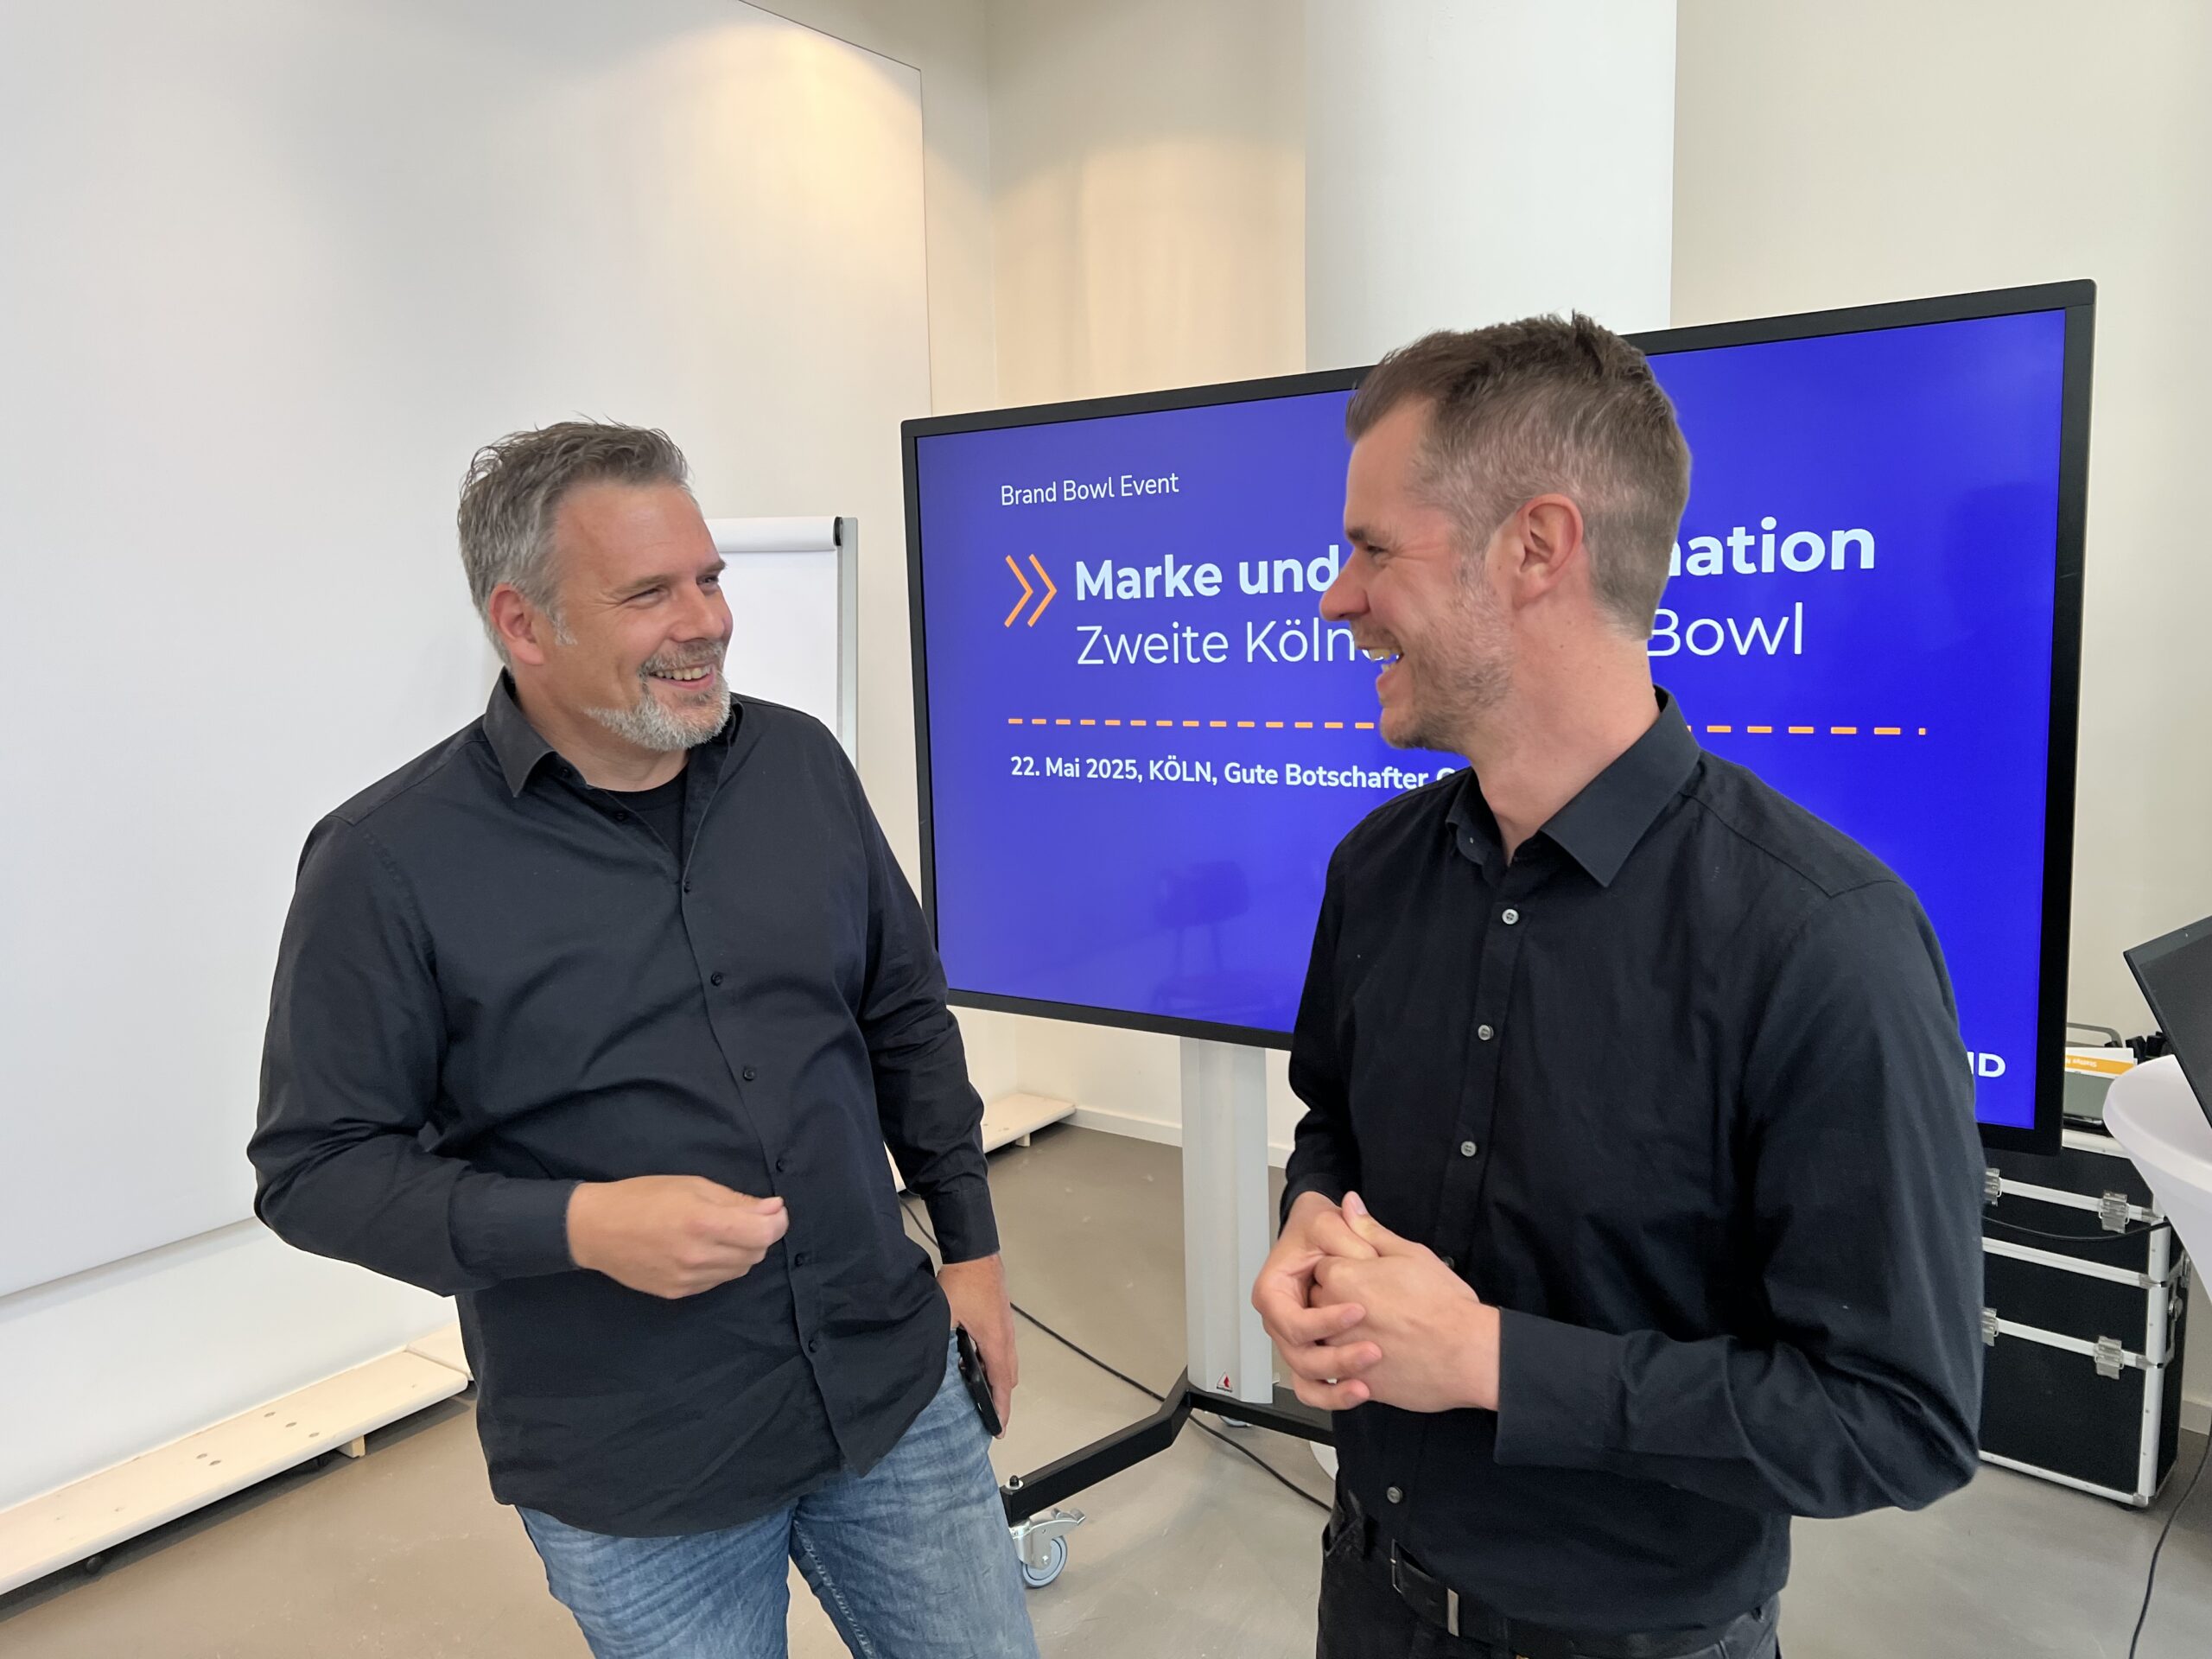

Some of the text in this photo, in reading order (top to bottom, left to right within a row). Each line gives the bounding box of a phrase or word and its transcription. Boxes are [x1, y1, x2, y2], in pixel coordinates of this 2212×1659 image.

[1001, 472, 1179, 506] Brand Bowl Event
[1075, 554, 1223, 601] Marke
[1239, 544, 1339, 594] und
[1077, 601, 1803, 665] Zweite Köln Bowl
[1010, 755, 1040, 777] 22.
[1046, 757, 1080, 778] Mai
[1085, 758, 1143, 784] 2025,
[1149, 754, 1217, 786] KÖLN,
[1224, 762, 1279, 785] Gute
[1286, 763, 1429, 790] Botschafter
